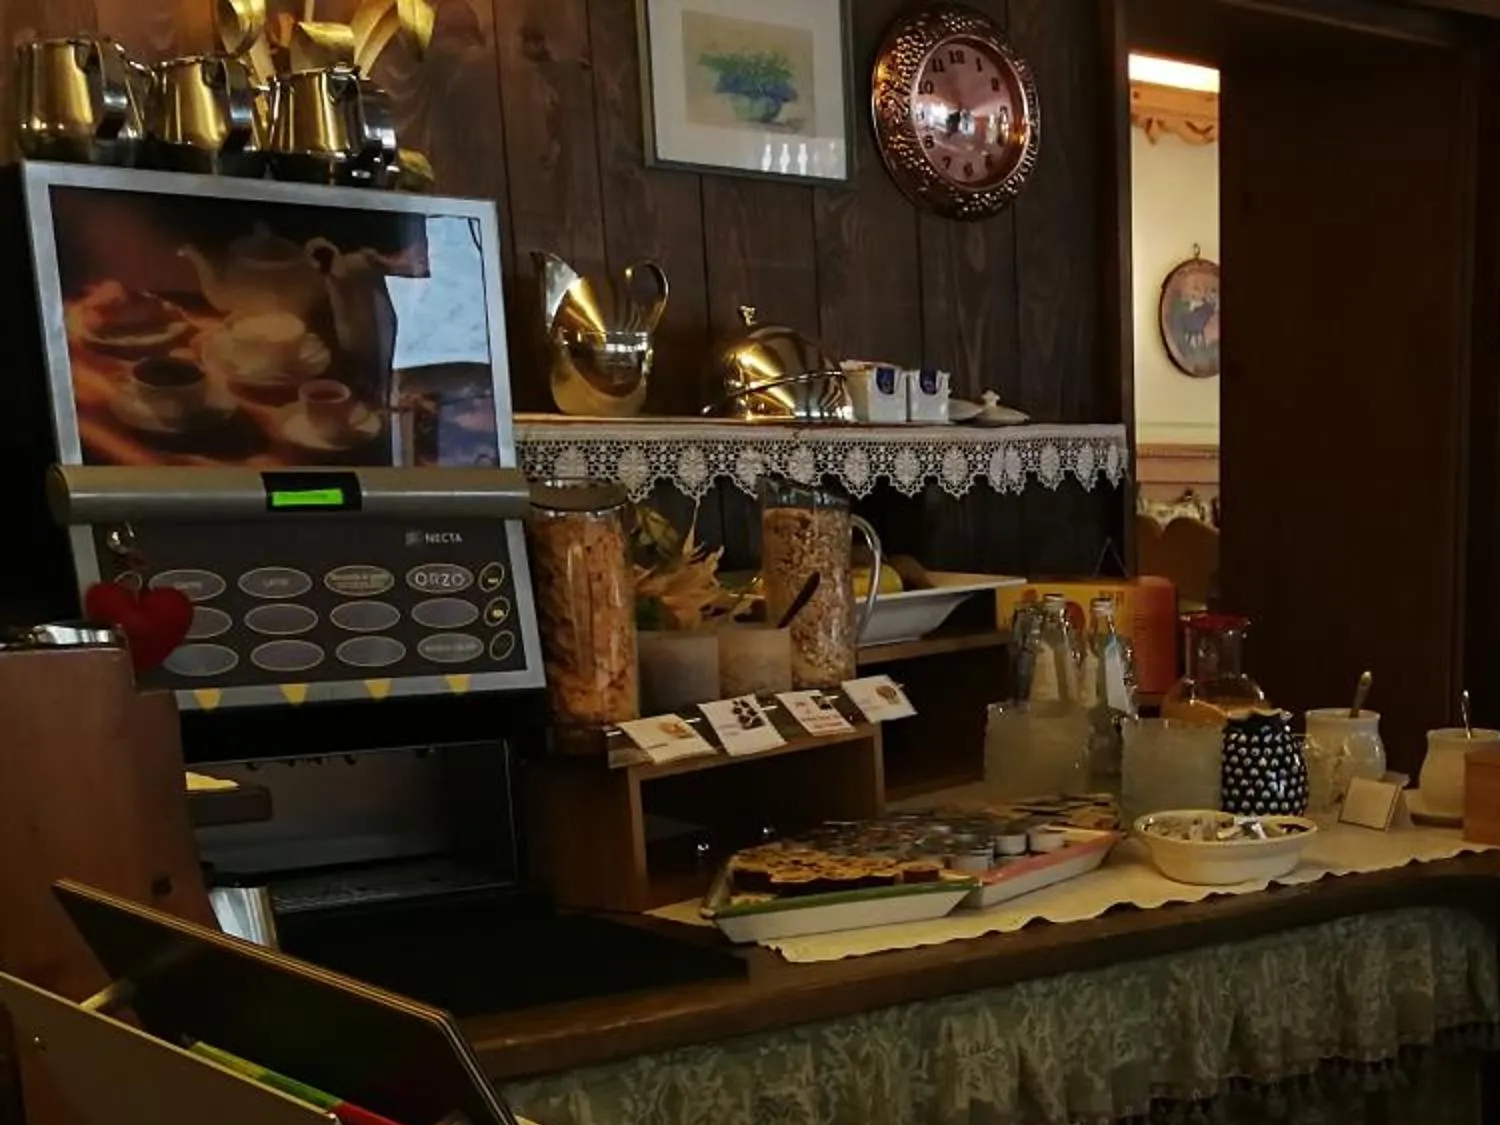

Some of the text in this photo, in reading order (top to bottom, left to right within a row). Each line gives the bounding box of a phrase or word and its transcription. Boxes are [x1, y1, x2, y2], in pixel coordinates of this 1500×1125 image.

[949, 50, 966, 65] 12
[932, 58, 945, 73] 11
[918, 80, 934, 95] 10
[942, 155, 952, 170] 7
[425, 532, 463, 544] NECTA
[415, 571, 465, 587] ORZO
